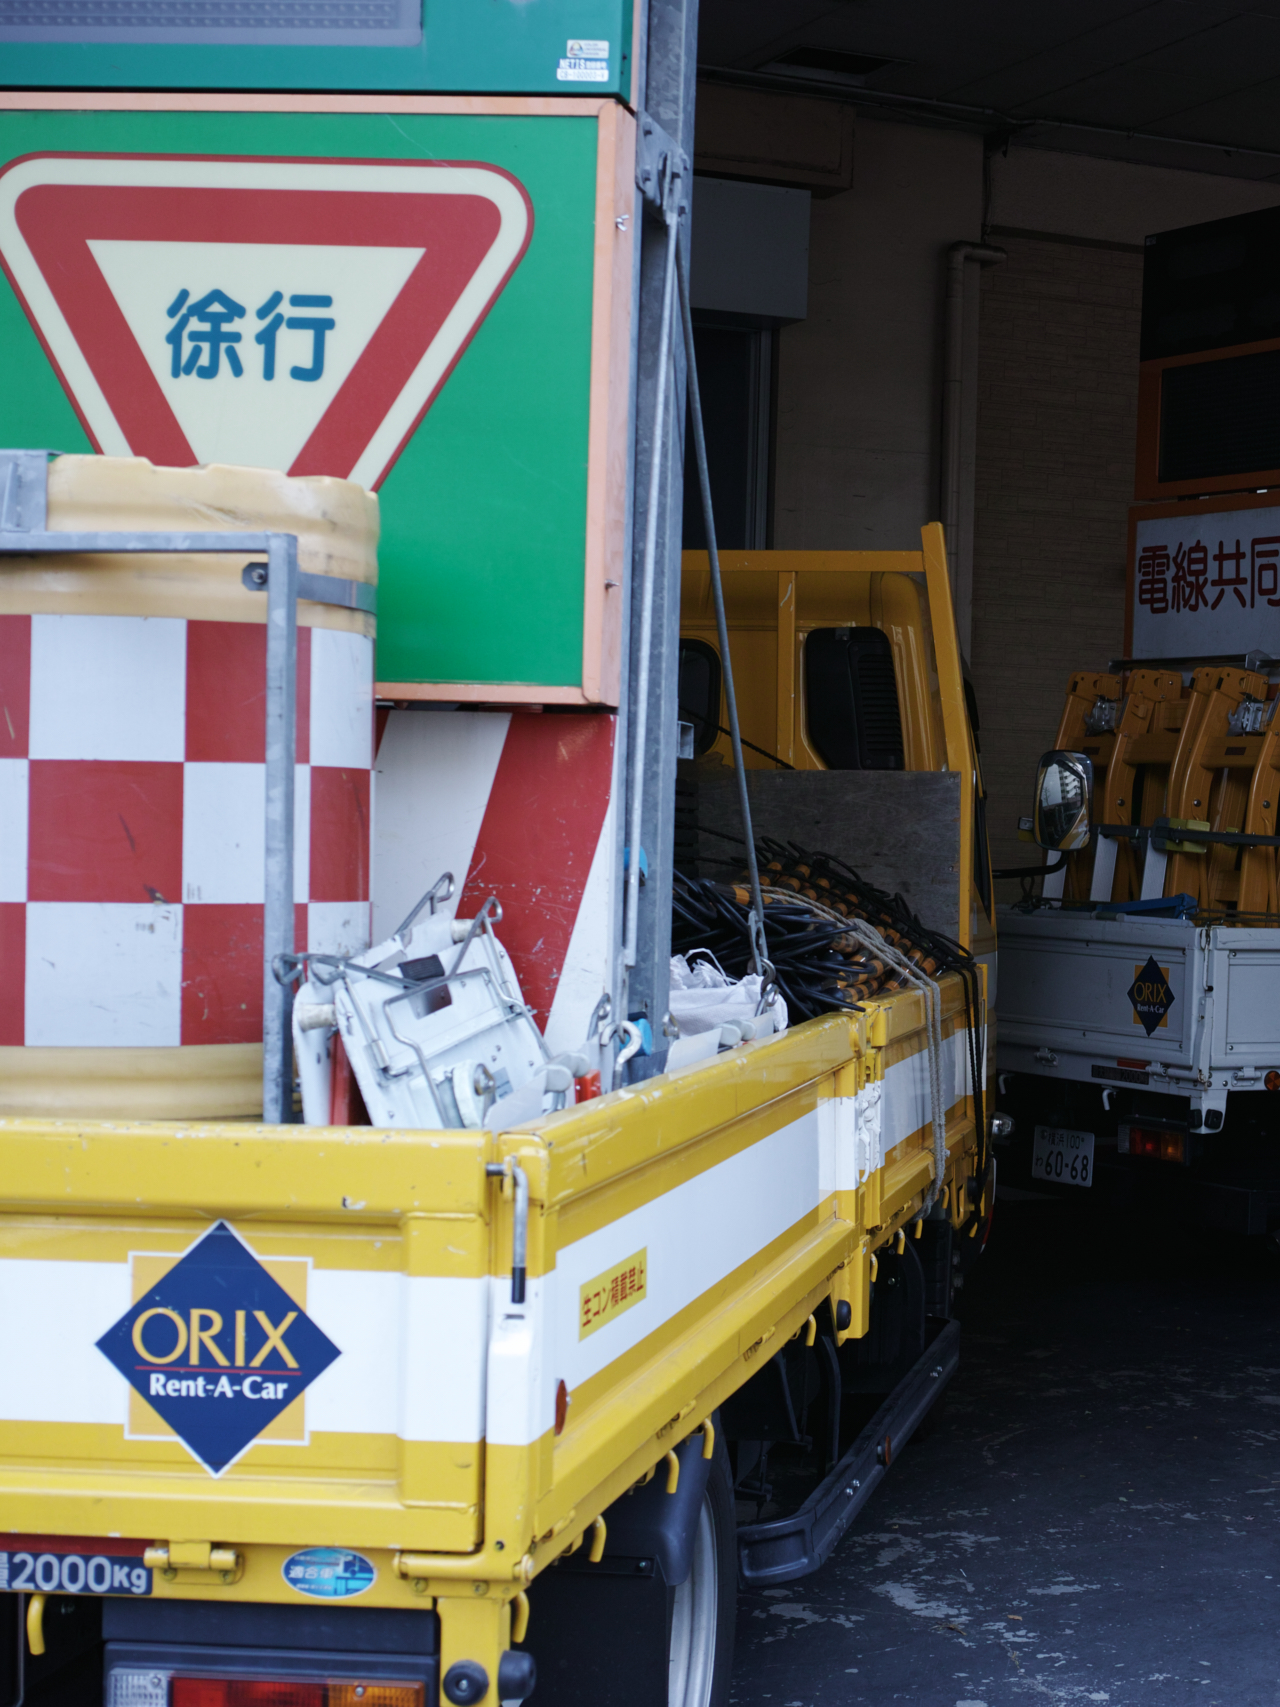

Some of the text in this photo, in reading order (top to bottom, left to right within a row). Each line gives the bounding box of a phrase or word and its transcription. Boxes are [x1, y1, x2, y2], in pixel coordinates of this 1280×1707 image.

[165, 288, 336, 382] 徐行
[1134, 981, 1167, 1004] ORIX
[1136, 1003, 1165, 1014] Rent-A-Car
[1045, 1150, 1089, 1182] 60-68
[132, 1307, 300, 1369] ORIX
[149, 1373, 288, 1400] Rent-A-Car
[288, 1565, 333, 1579] 適合車
